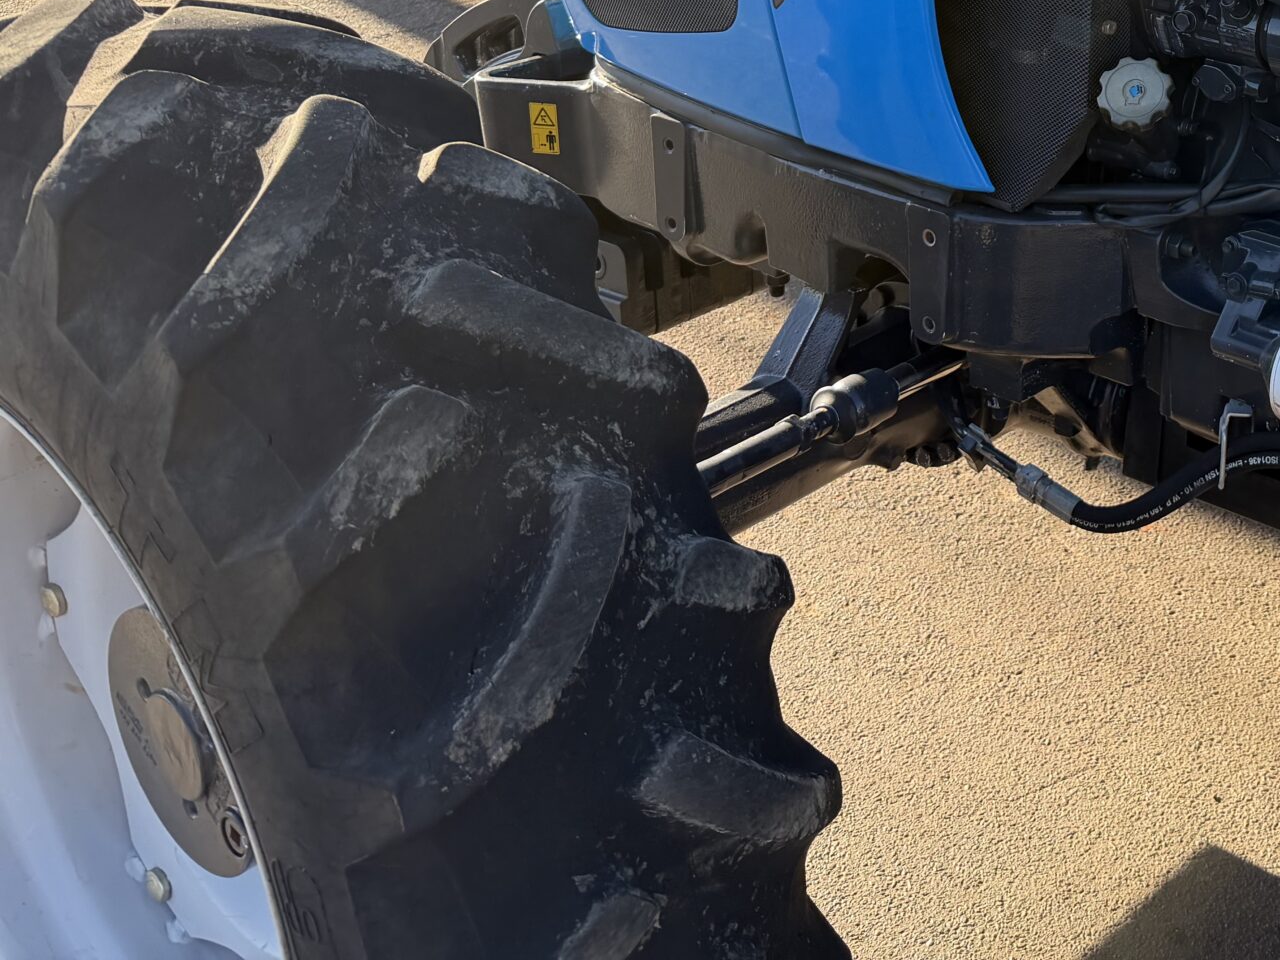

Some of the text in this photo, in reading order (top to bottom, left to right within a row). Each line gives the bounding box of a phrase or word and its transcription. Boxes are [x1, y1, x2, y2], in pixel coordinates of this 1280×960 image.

[1248, 455, 1280, 466] ISO1436
[1205, 468, 1220, 482] 1SN
[1184, 485, 1194, 494] 10
